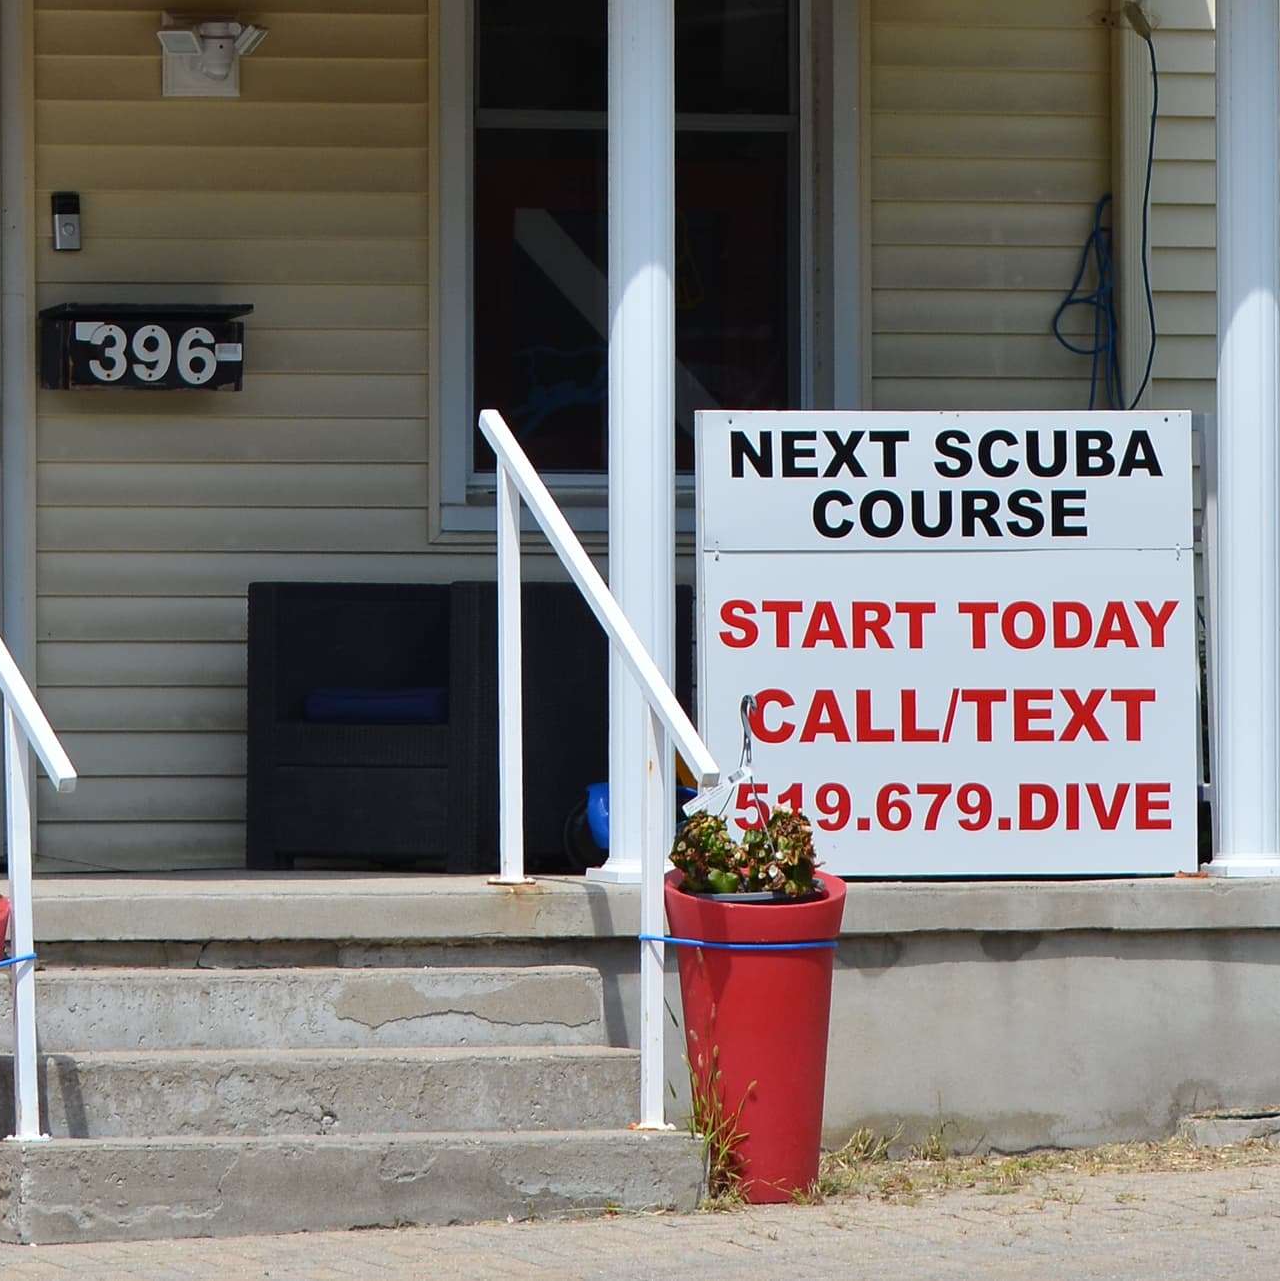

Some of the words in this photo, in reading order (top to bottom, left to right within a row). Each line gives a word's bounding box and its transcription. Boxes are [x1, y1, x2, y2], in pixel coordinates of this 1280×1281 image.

[88, 323, 218, 385] 396
[730, 429, 910, 478] NEXT
[933, 428, 1163, 479] SCUBA
[811, 489, 1088, 539] COURSE
[718, 599, 937, 650] START
[958, 599, 1181, 651] TODAY
[748, 687, 1157, 745] CALL/TEXT
[734, 782, 1174, 832] 519.679.DIVE
